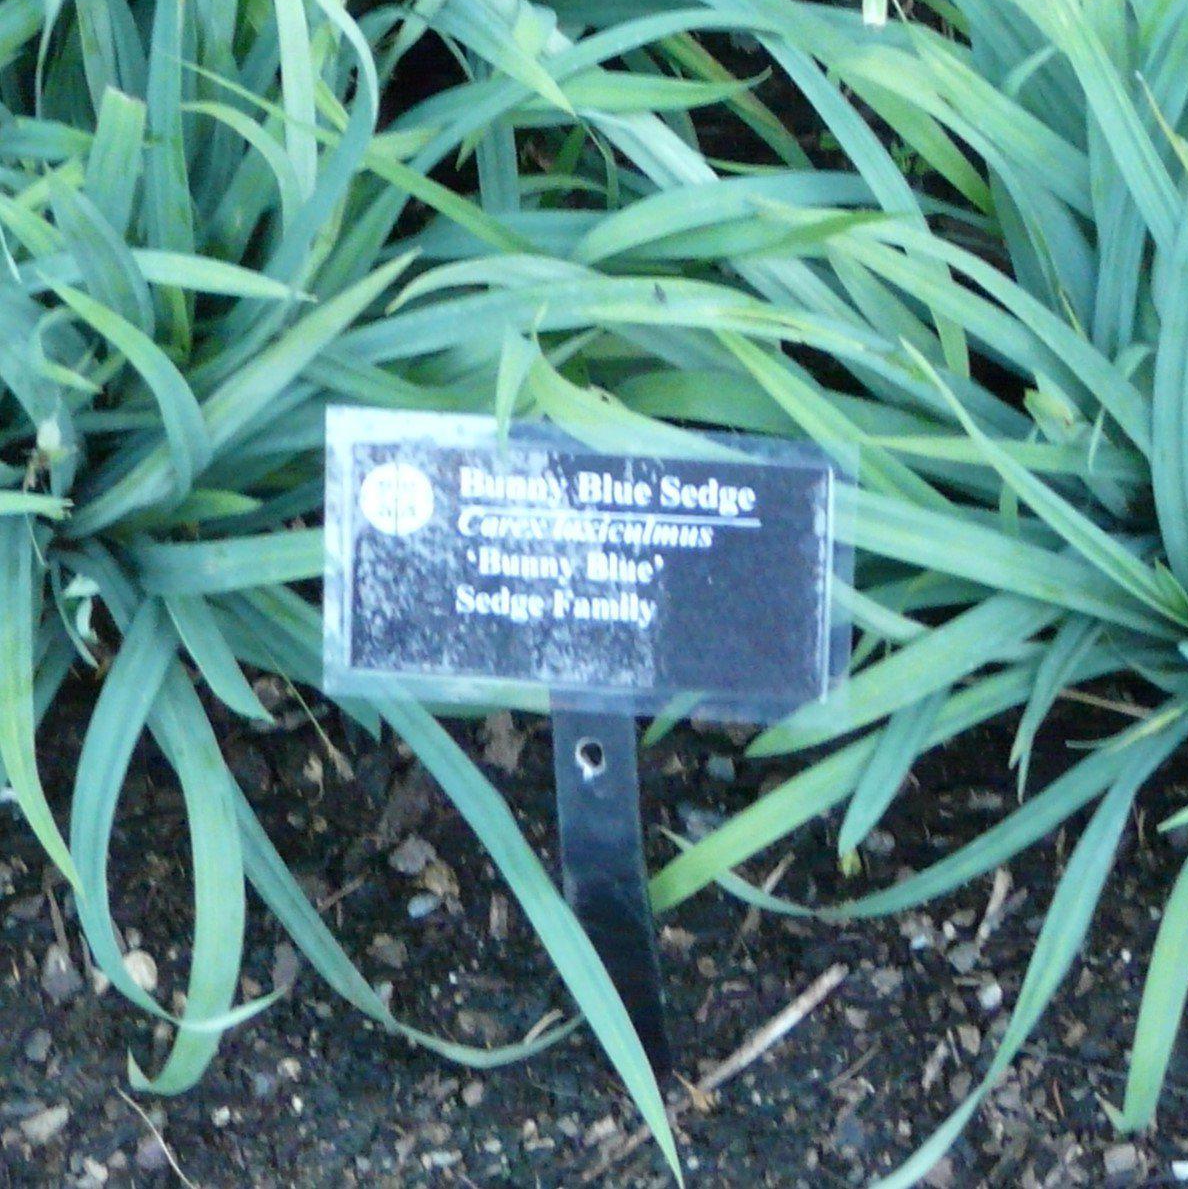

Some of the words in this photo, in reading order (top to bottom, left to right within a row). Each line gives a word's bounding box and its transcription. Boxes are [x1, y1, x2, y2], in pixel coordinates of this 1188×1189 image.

[459, 466, 563, 507] Bunny
[578, 471, 652, 506] Blue
[660, 475, 756, 516] Sedge
[457, 508, 544, 539] Carex
[455, 584, 544, 622] Sedge
[554, 589, 656, 628] Family
